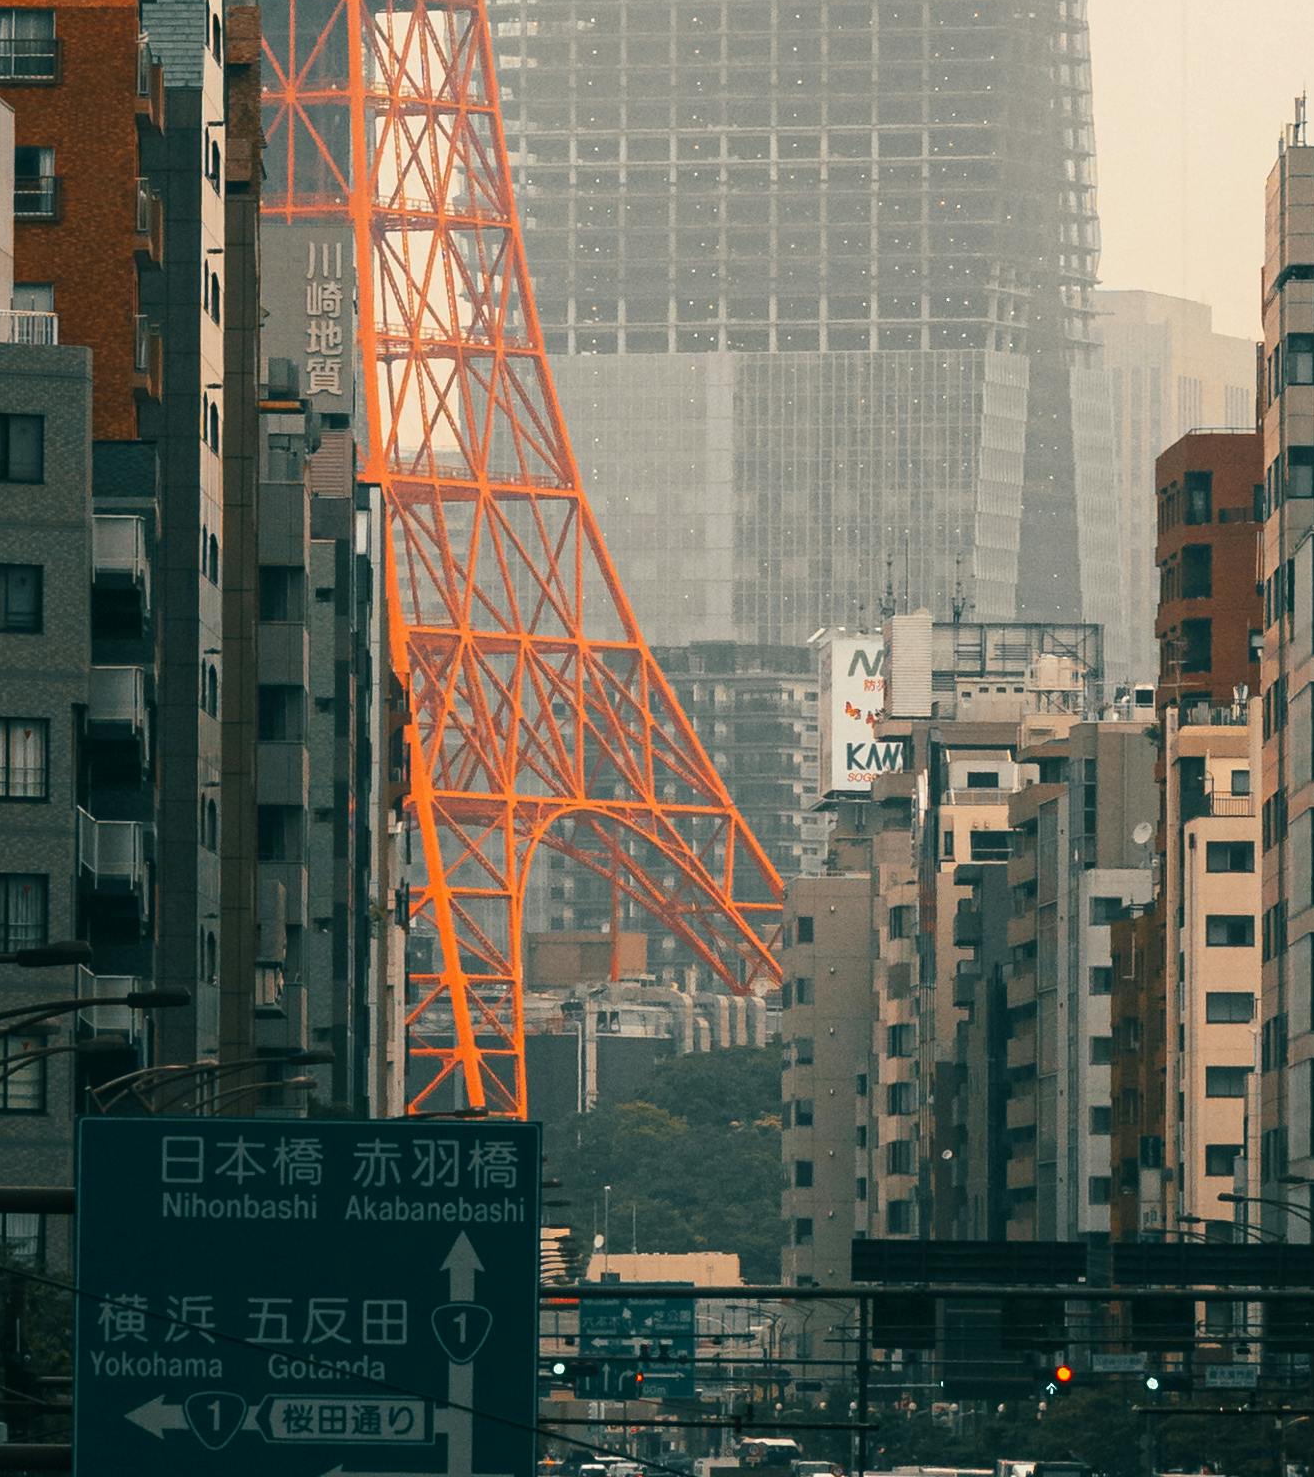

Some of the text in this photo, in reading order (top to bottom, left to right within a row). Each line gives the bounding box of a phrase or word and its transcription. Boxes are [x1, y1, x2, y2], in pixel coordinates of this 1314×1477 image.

[306, 242, 343, 396] 川崎地質
[161, 1135, 519, 1190] 日本橋 赤羽橋
[161, 1192, 526, 1223] Nihonbashi Akabanebashi
[97, 1293, 409, 1345] 横浜 五反田
[452, 1312, 468, 1344] 1
[89, 1351, 387, 1381] Yokohama Gotanda
[207, 1400, 222, 1431] 1
[281, 1403, 415, 1436] 桜田通り
